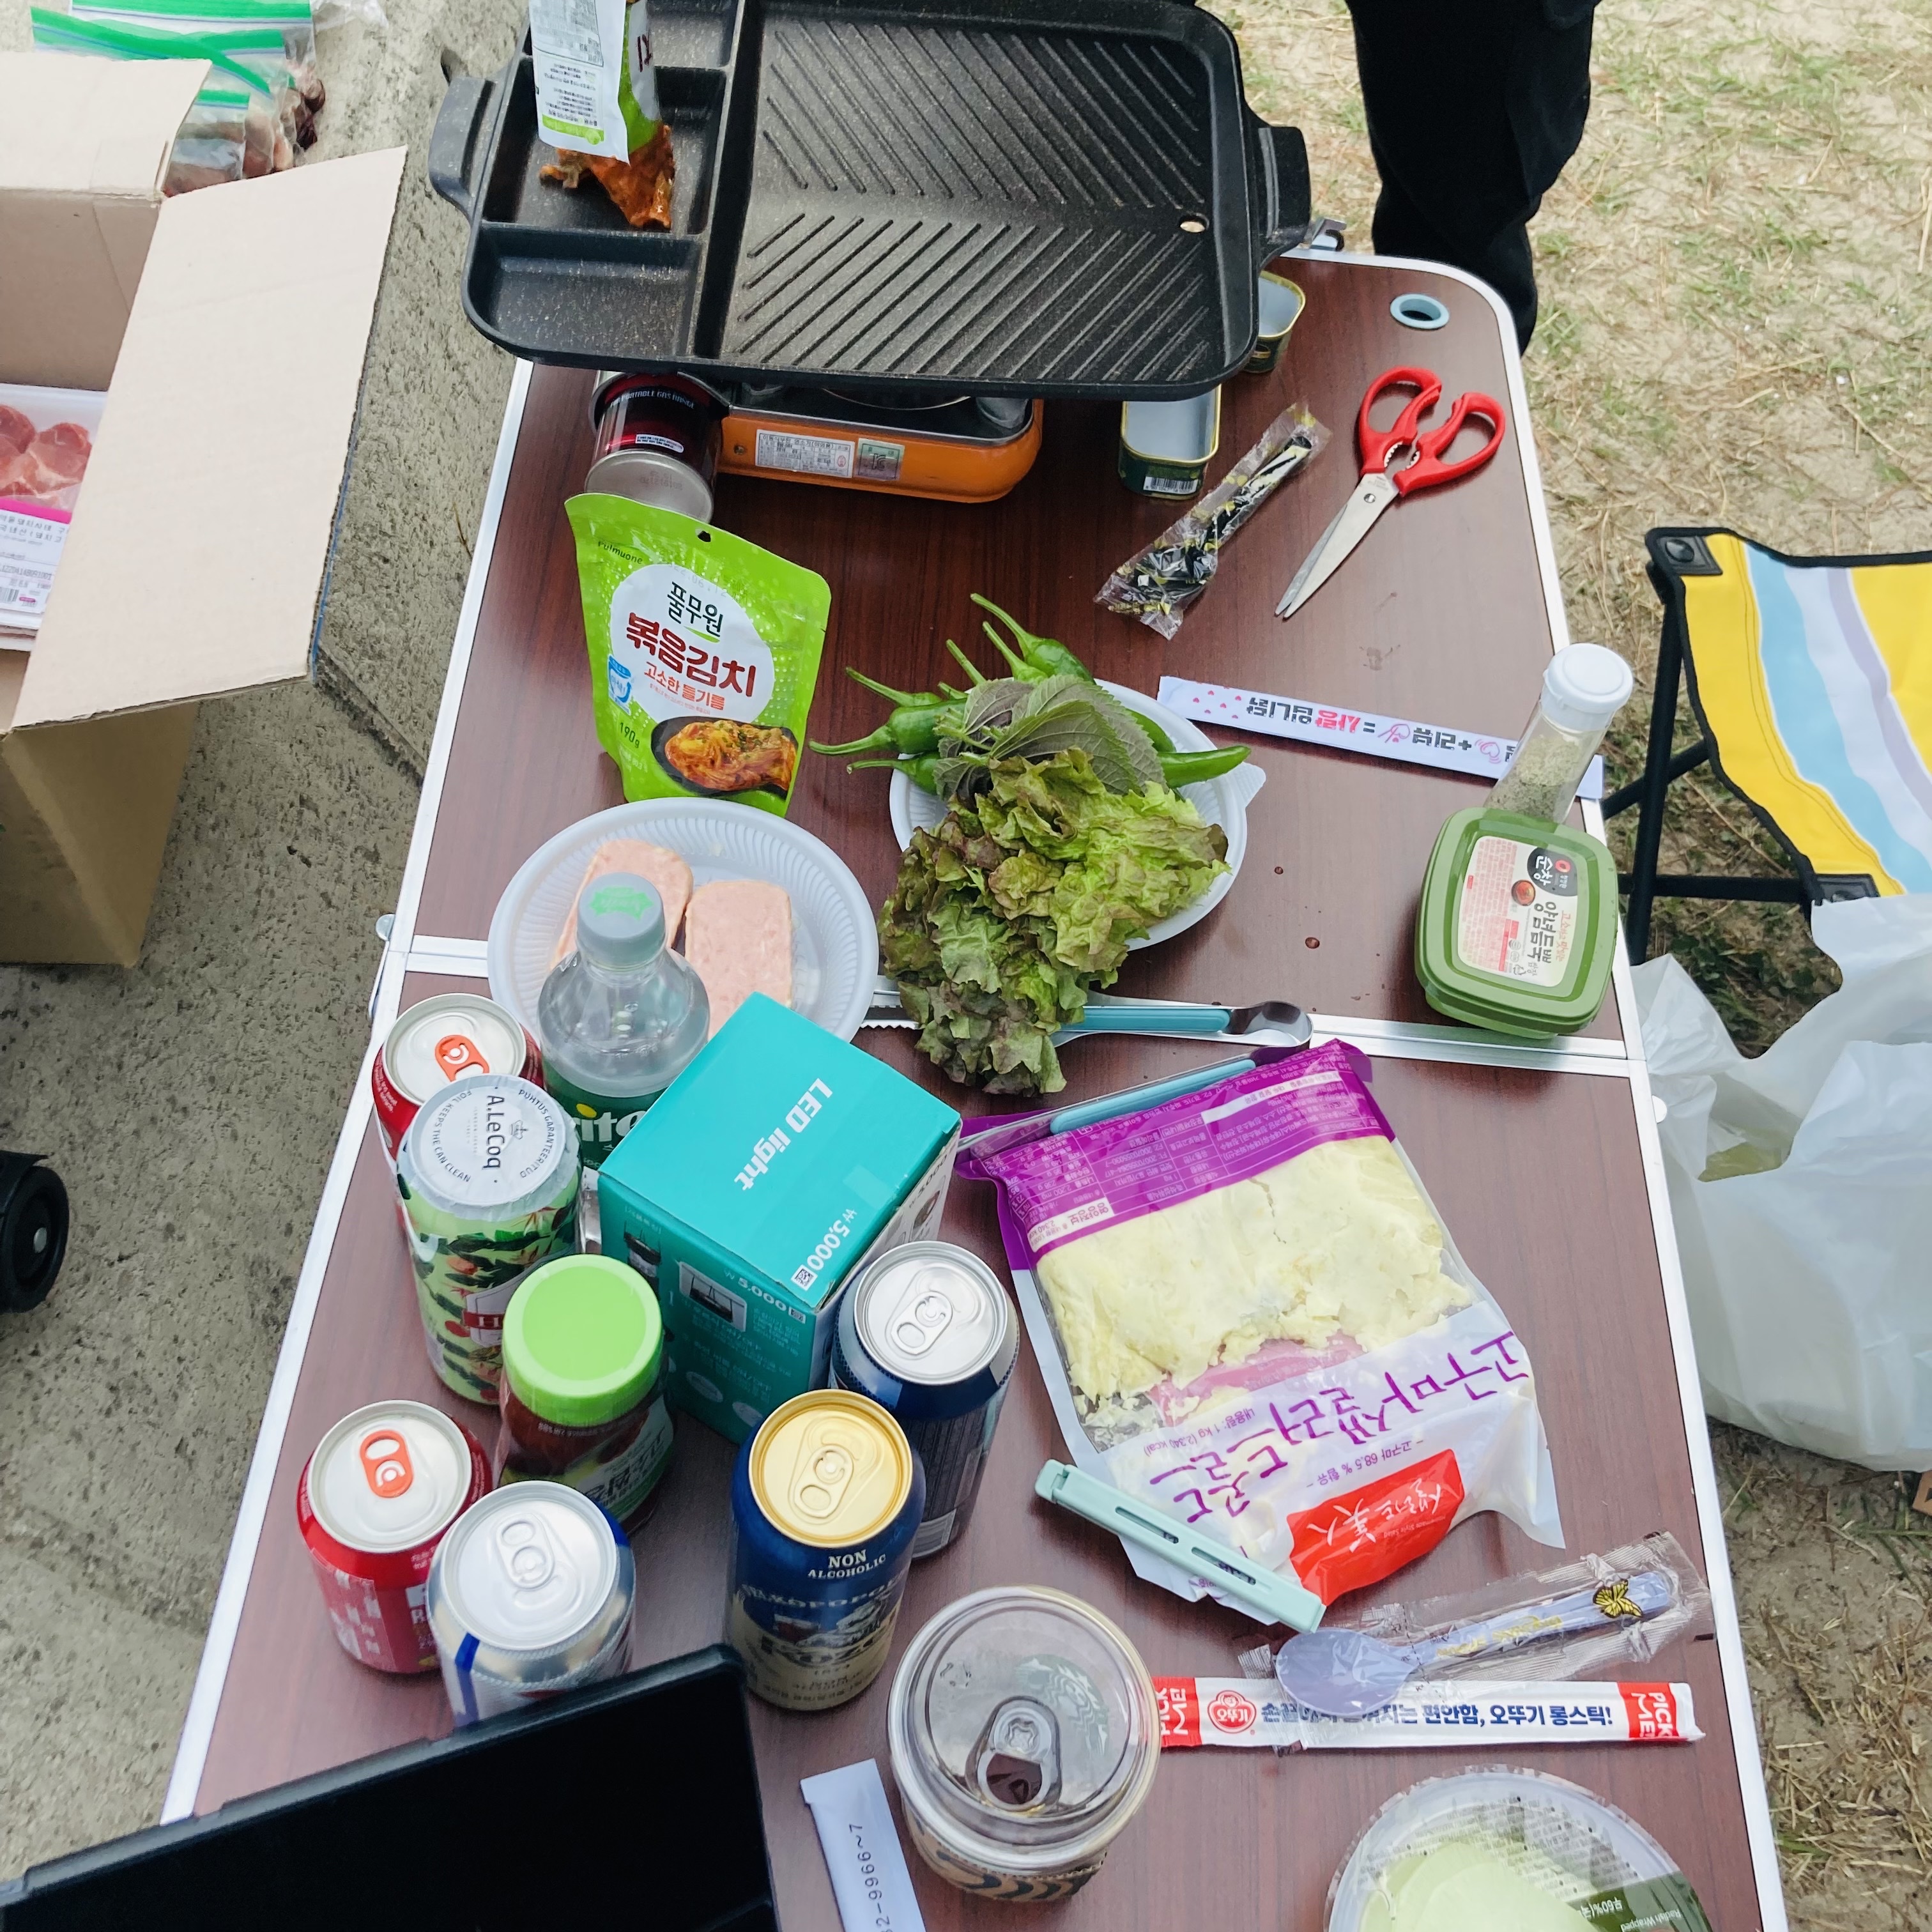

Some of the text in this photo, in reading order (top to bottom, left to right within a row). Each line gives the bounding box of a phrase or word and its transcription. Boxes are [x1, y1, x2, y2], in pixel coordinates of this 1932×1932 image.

[657, 391, 671, 401] GAS
[598, 540, 643, 565] Pulmuone
[667, 581, 724, 638] 풀무원
[625, 611, 757, 698] 볶음김치
[643, 661, 680, 695] 고소한
[682, 683, 726, 710] 들기름
[619, 722, 640, 748] 190g
[1531, 854, 1555, 886] 순창
[1526, 899, 1560, 964] 양념듬뿍
[432, 1090, 473, 1183] FOIL KEEPS THE CAN CLEAN
[518, 1089, 555, 1179] PUHTUS GARANTEERITUD
[734, 1078, 833, 1191] LED light
[1183, 1149, 1208, 1164] 유통기한
[1044, 1179, 1056, 1190] 238
[1163, 1173, 1172, 1182] kg
[1016, 1193, 1023, 1204] 73
[1041, 1192, 1052, 1200] mg
[1054, 1184, 1071, 1197] 2,200
[1038, 1220, 1054, 1234] 2,340
[1067, 1202, 1109, 1228] 영양정보
[1220, 1406, 1256, 1430] 내용량:
[1195, 1424, 1212, 1440] kg
[1141, 1438, 1169, 1460] kcal)
[1315, 1439, 1414, 1487] 고구마 68.5 % 함유
[1302, 1473, 1447, 1563] 샐러드 美人
[1399, 1523, 1415, 1535] Style
[1382, 1528, 1400, 1539] Salad
[808, 1554, 886, 1579] ALCOHOLIC
[828, 1549, 867, 1569] NON
[1216, 1708, 1250, 1722] 오뚜기
[1423, 1703, 1485, 1727] 편안함,
[1489, 1704, 1545, 1726] 오뚜기
[1549, 1704, 1613, 1726] 롱스틱!
[1648, 1691, 1673, 1738] PICK
[848, 1823, 894, 1932] 2-9966~7
[1620, 1908, 1682, 1932] Radish Wrapped
